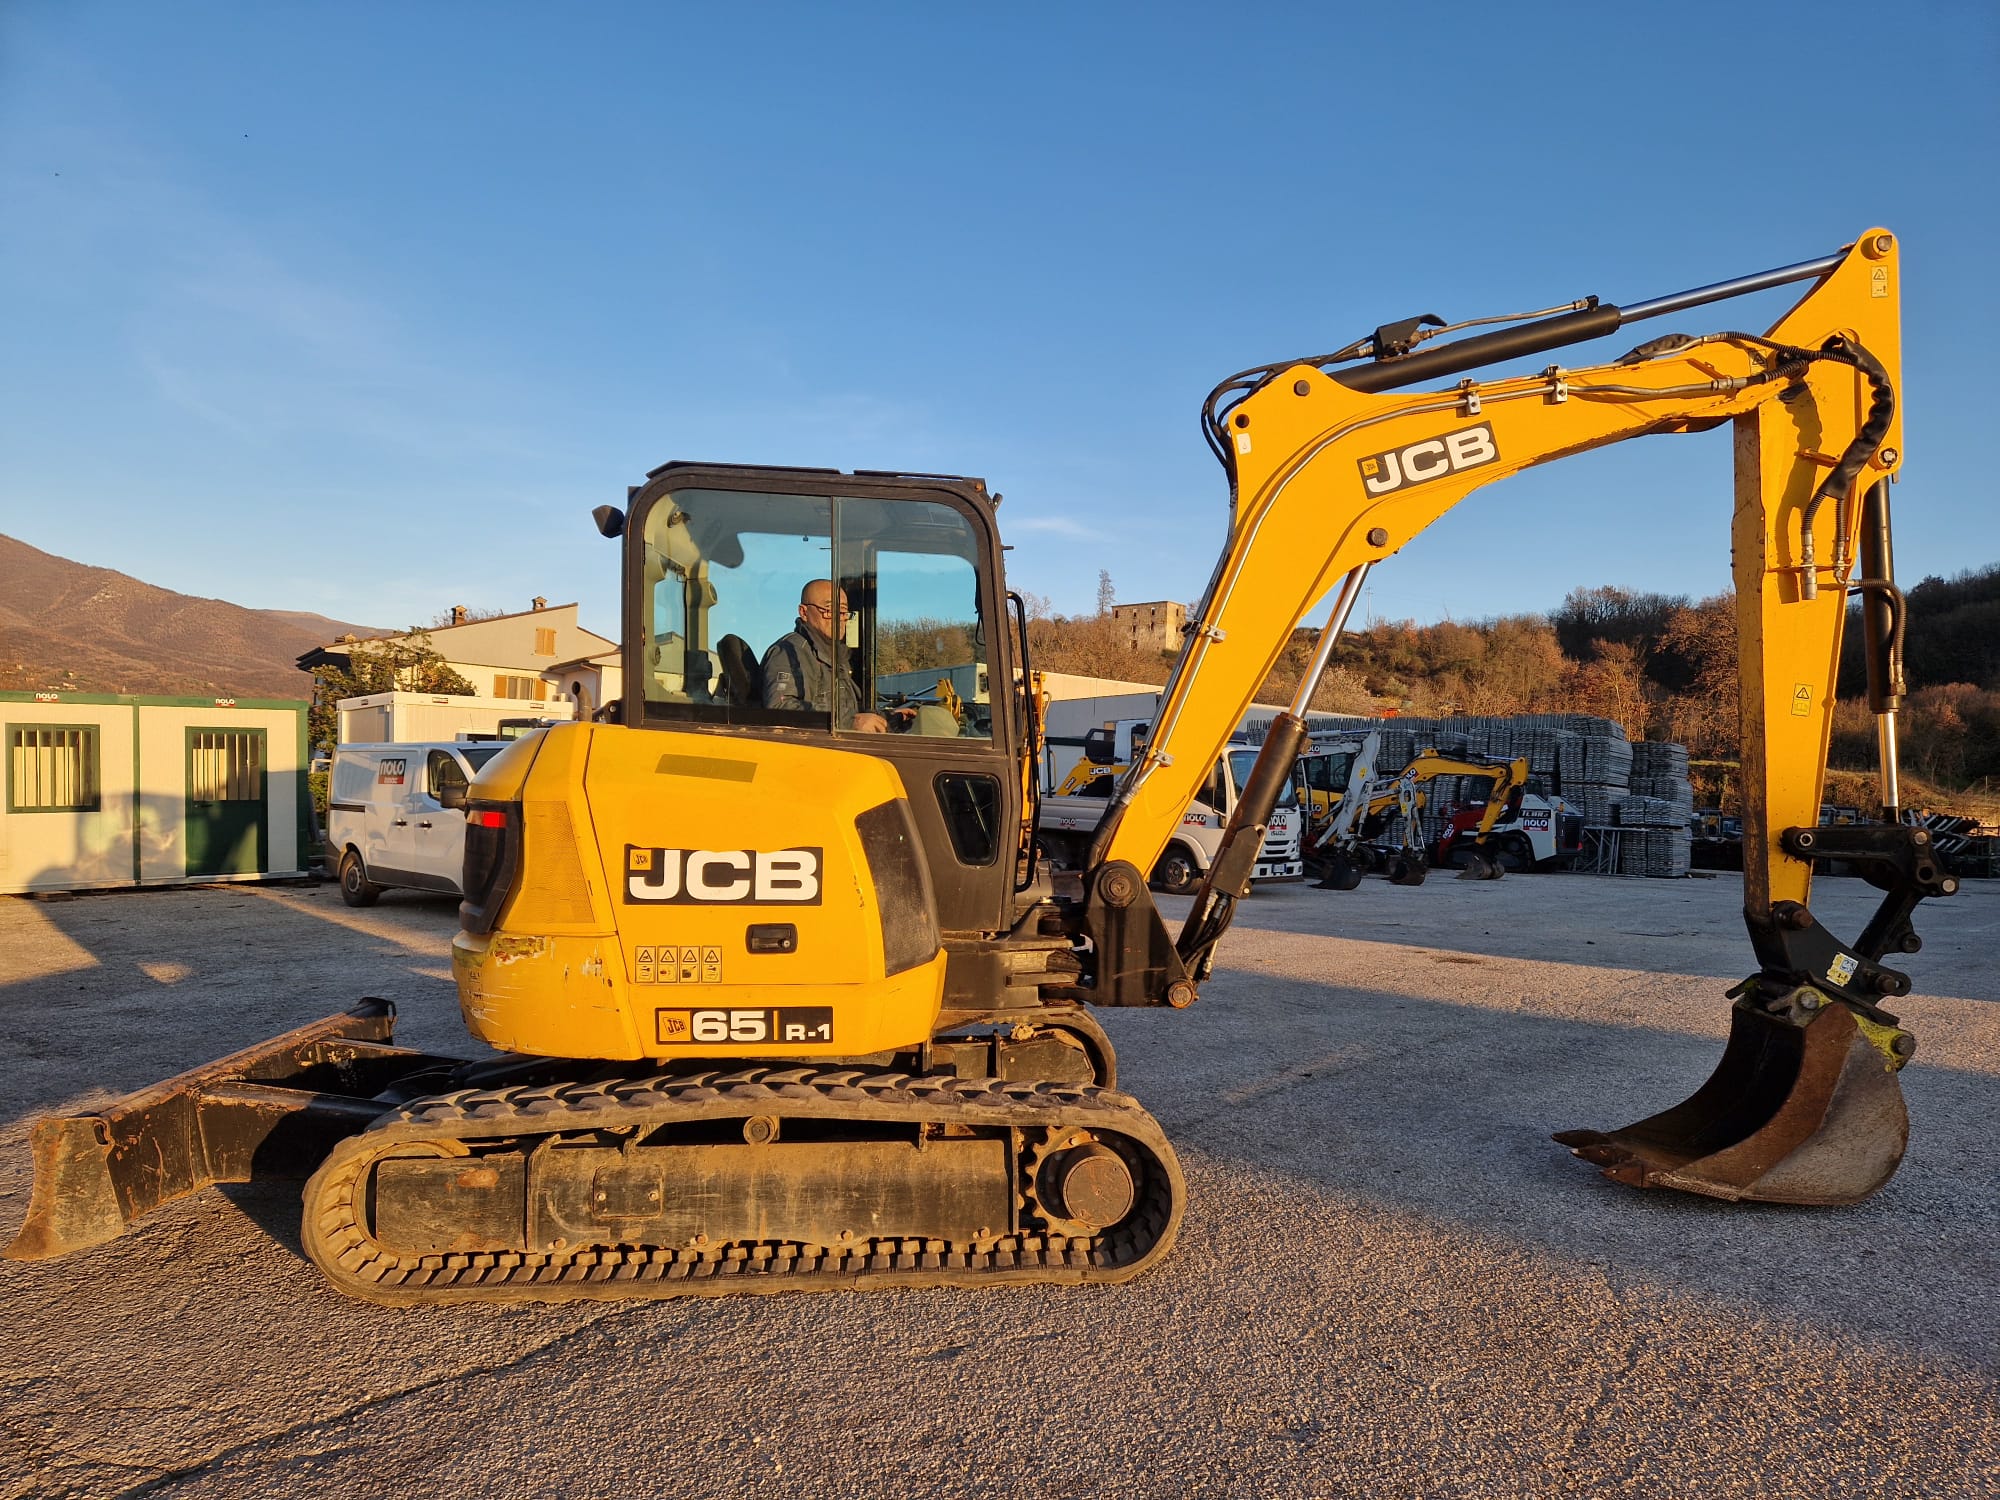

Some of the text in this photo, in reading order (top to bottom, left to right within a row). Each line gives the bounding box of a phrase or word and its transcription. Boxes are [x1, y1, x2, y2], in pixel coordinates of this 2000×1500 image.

[1366, 427, 1496, 493] JCB
[1090, 767, 1111, 775] JCB
[629, 850, 818, 901] JCB
[665, 1018, 687, 1034] JCB
[692, 1010, 831, 1042] 65 R-1
